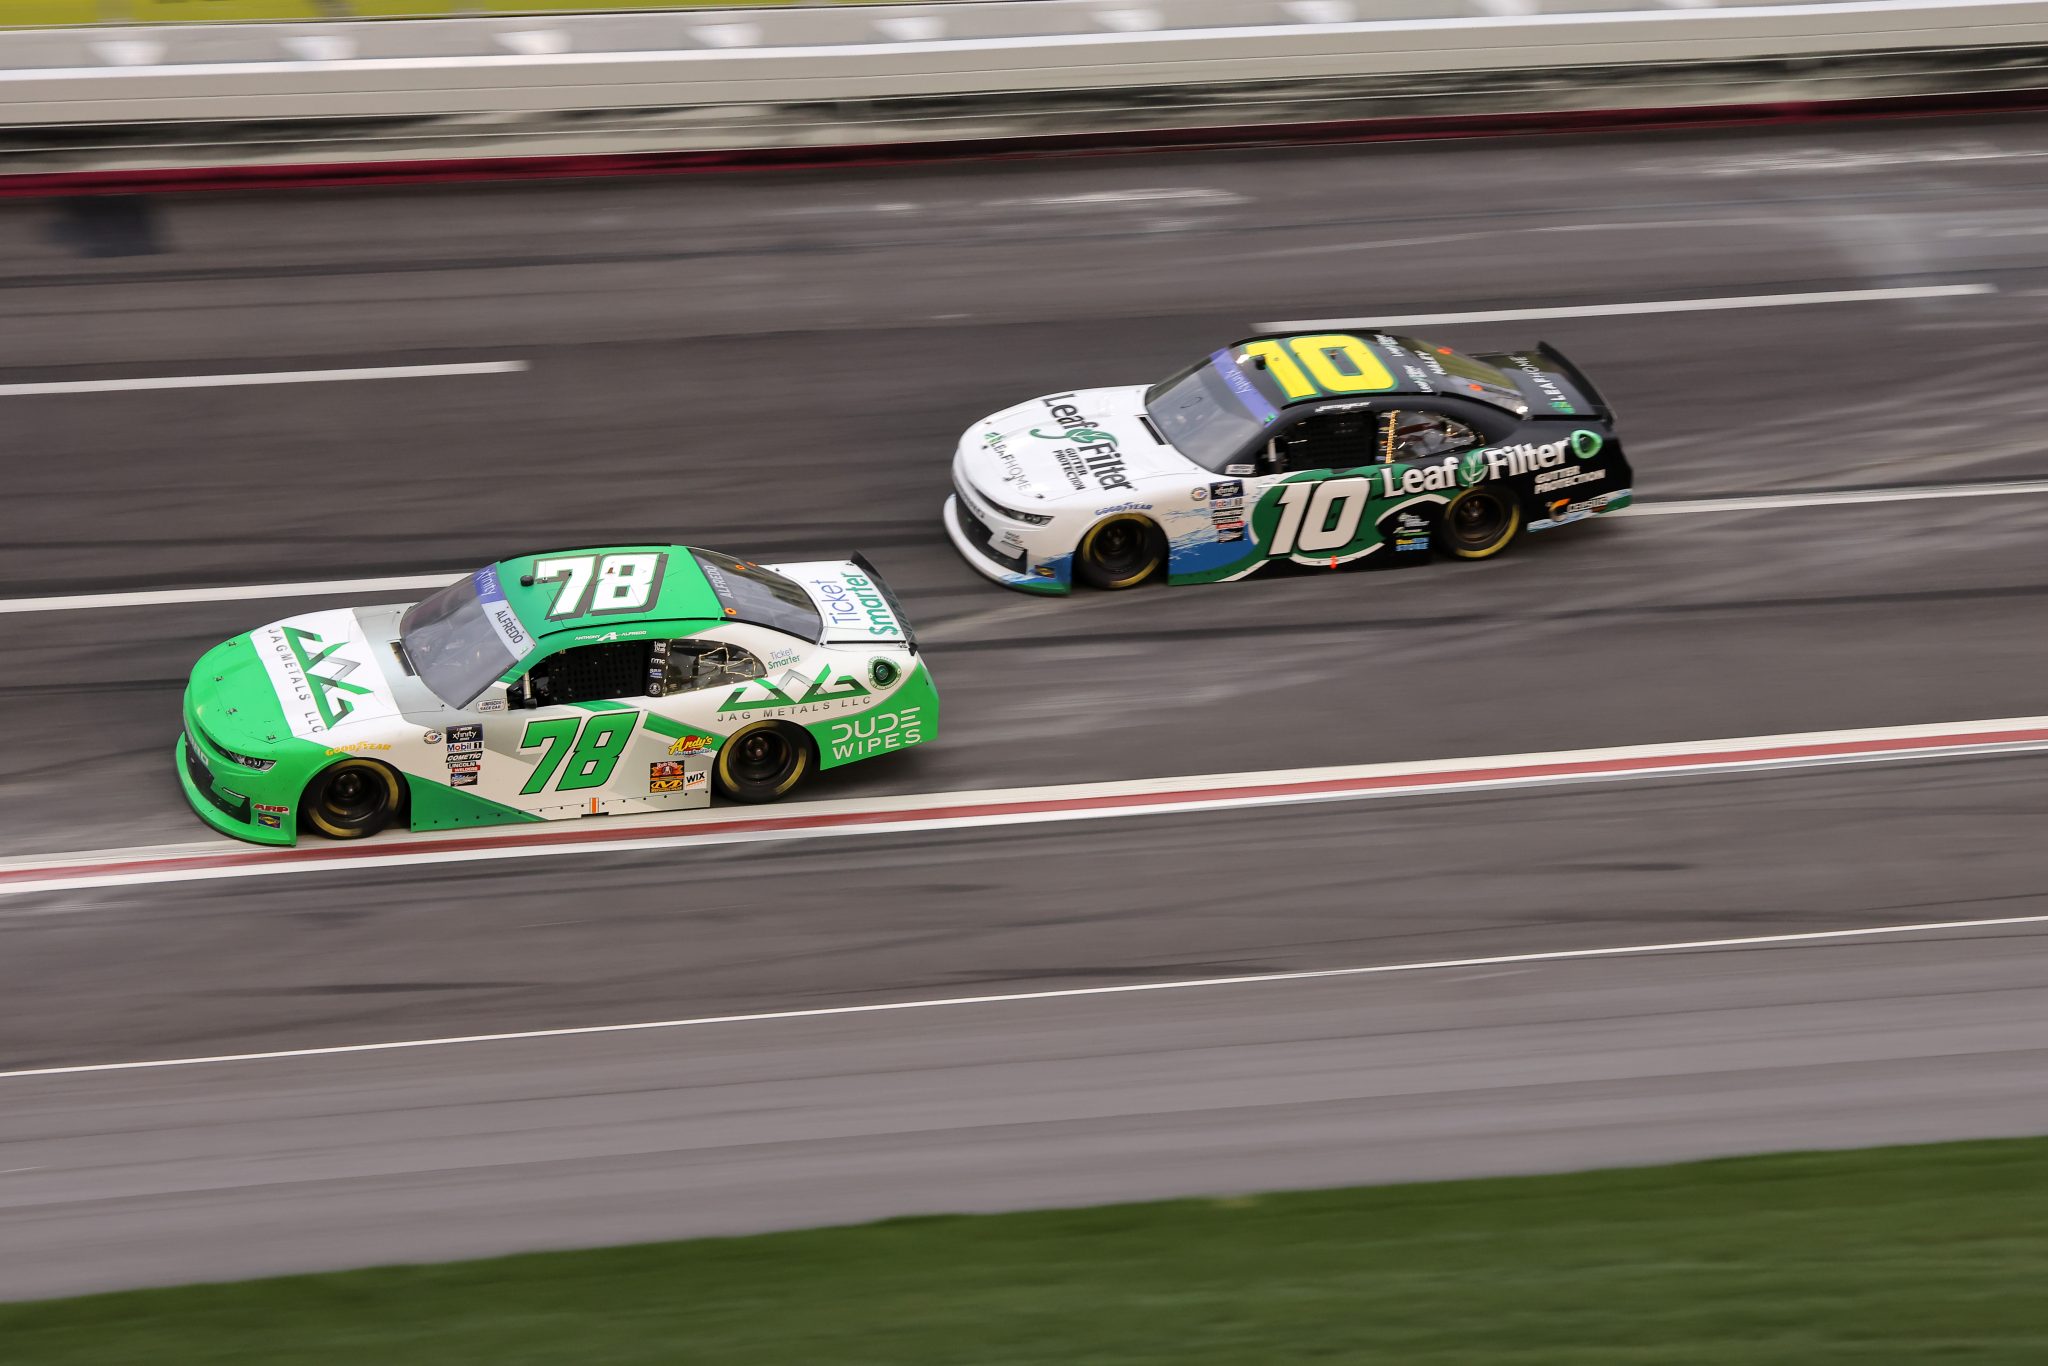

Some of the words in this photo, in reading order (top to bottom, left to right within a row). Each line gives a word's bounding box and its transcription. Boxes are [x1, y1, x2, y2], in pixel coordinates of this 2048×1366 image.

[1226, 370, 1252, 394] xfinity
[1245, 334, 1394, 398] 10
[1042, 393, 1099, 430] Leaf
[1078, 442, 1134, 491] Filter
[1053, 450, 1086, 490] PROTECTION
[1065, 447, 1088, 476] GUTTER
[1380, 456, 1460, 499] Leaf
[1485, 440, 1568, 480] Filter
[1269, 476, 1371, 556] 10
[480, 568, 497, 596] xfinity
[535, 553, 660, 617] 78
[706, 565, 733, 599] ALFREDO
[810, 579, 861, 625] Ticket
[841, 571, 898, 636] Smarter
[494, 609, 524, 645] ALFREDO
[768, 654, 800, 670] Smarter
[770, 648, 793, 661] Ticket
[304, 711, 325, 734] LLC
[717, 712, 751, 722] JAG
[763, 702, 830, 718] METALS
[842, 696, 871, 707] LLC
[452, 731, 477, 740] xfinity
[832, 707, 921, 744] DUDE
[447, 742, 471, 752] Mobil
[519, 711, 640, 796] 78
[668, 735, 713, 755] Andy's
[832, 729, 921, 759] WIPES
[686, 772, 705, 783] WIX
